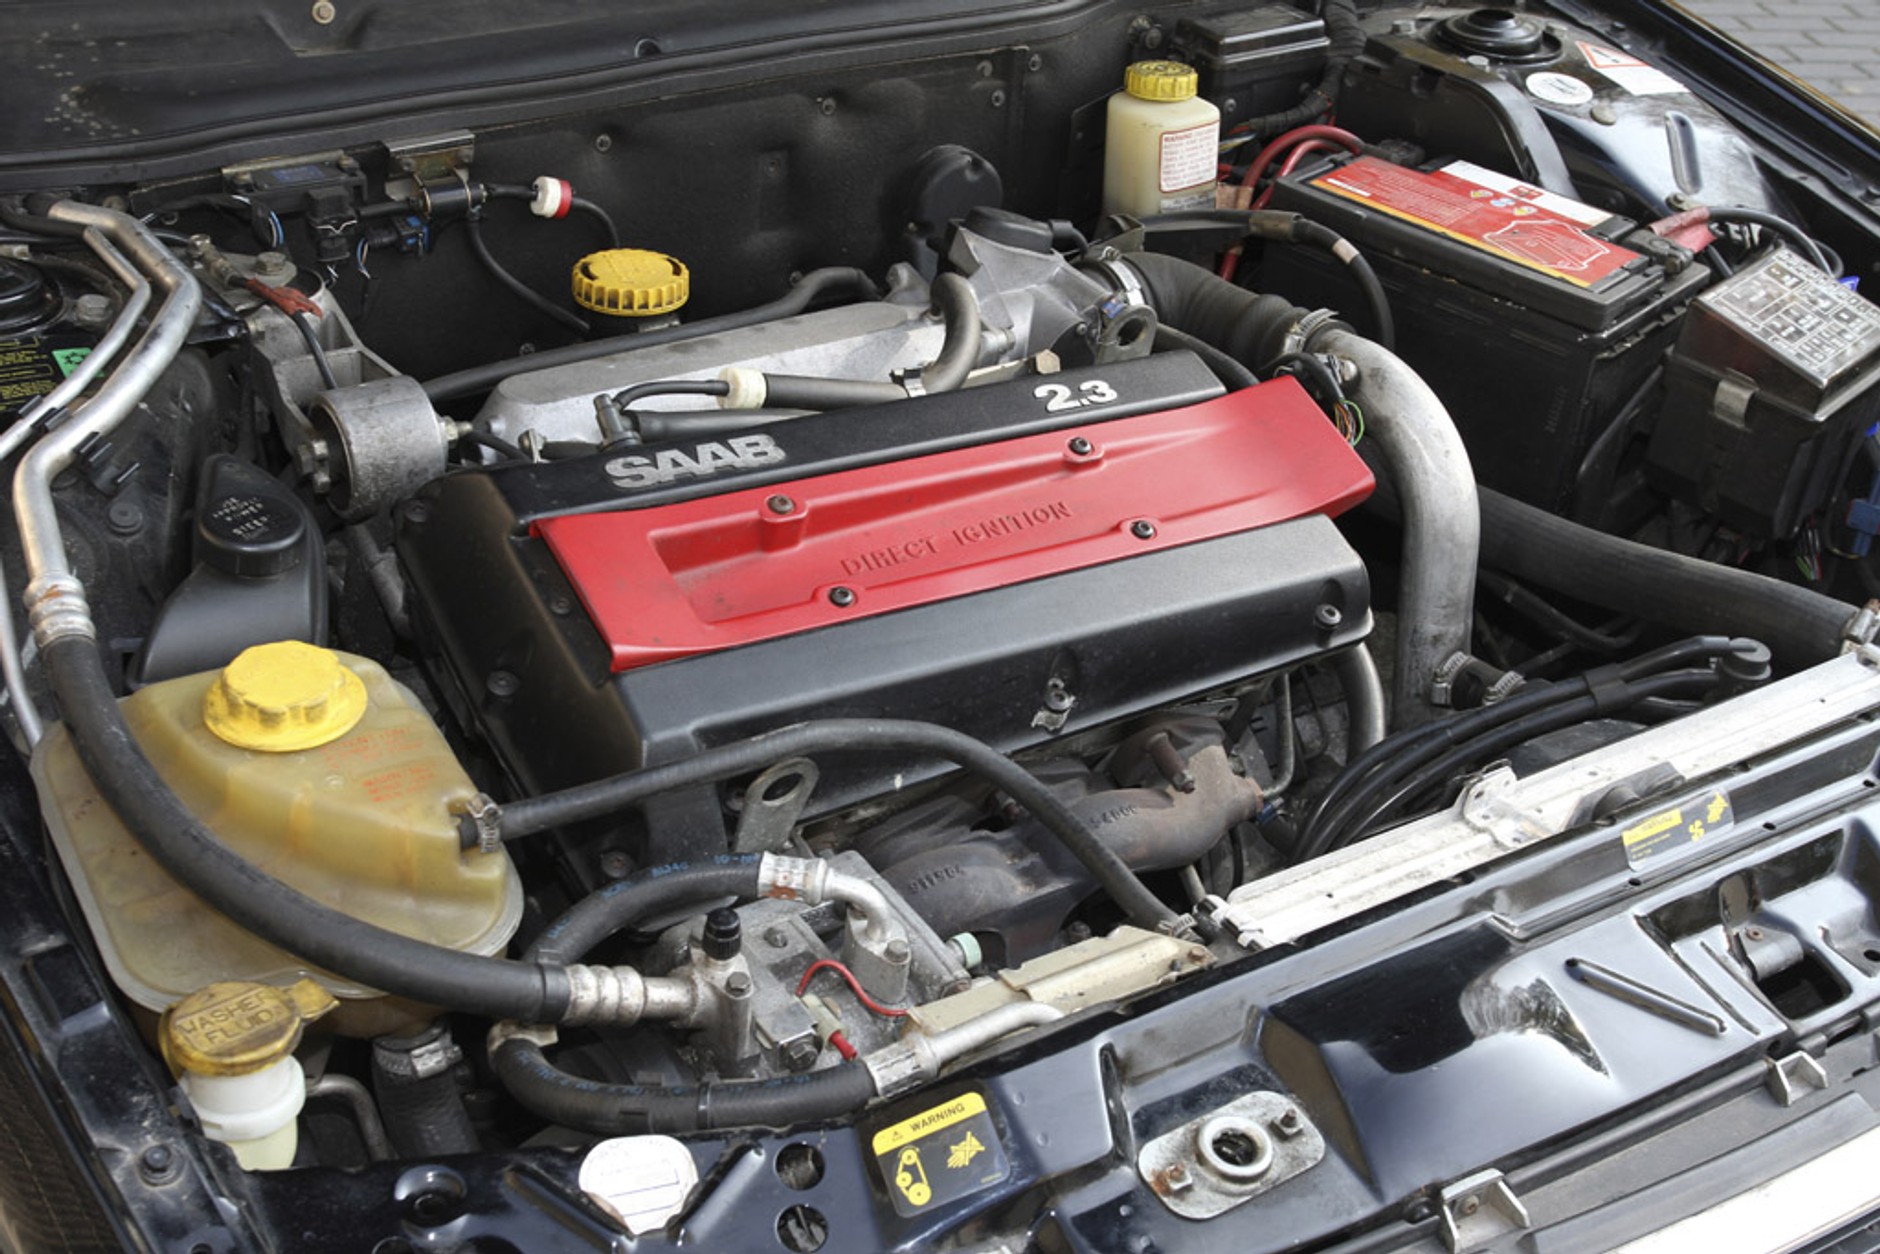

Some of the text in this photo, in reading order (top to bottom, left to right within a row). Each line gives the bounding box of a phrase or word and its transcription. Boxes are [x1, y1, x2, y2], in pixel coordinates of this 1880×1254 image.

[1033, 380, 1118, 412] 2.3
[605, 434, 786, 489] SAAB
[840, 501, 1072, 577] DIRECT IGNITION
[205, 1009, 275, 1044] FLUID
[910, 1102, 966, 1132] WARNING
